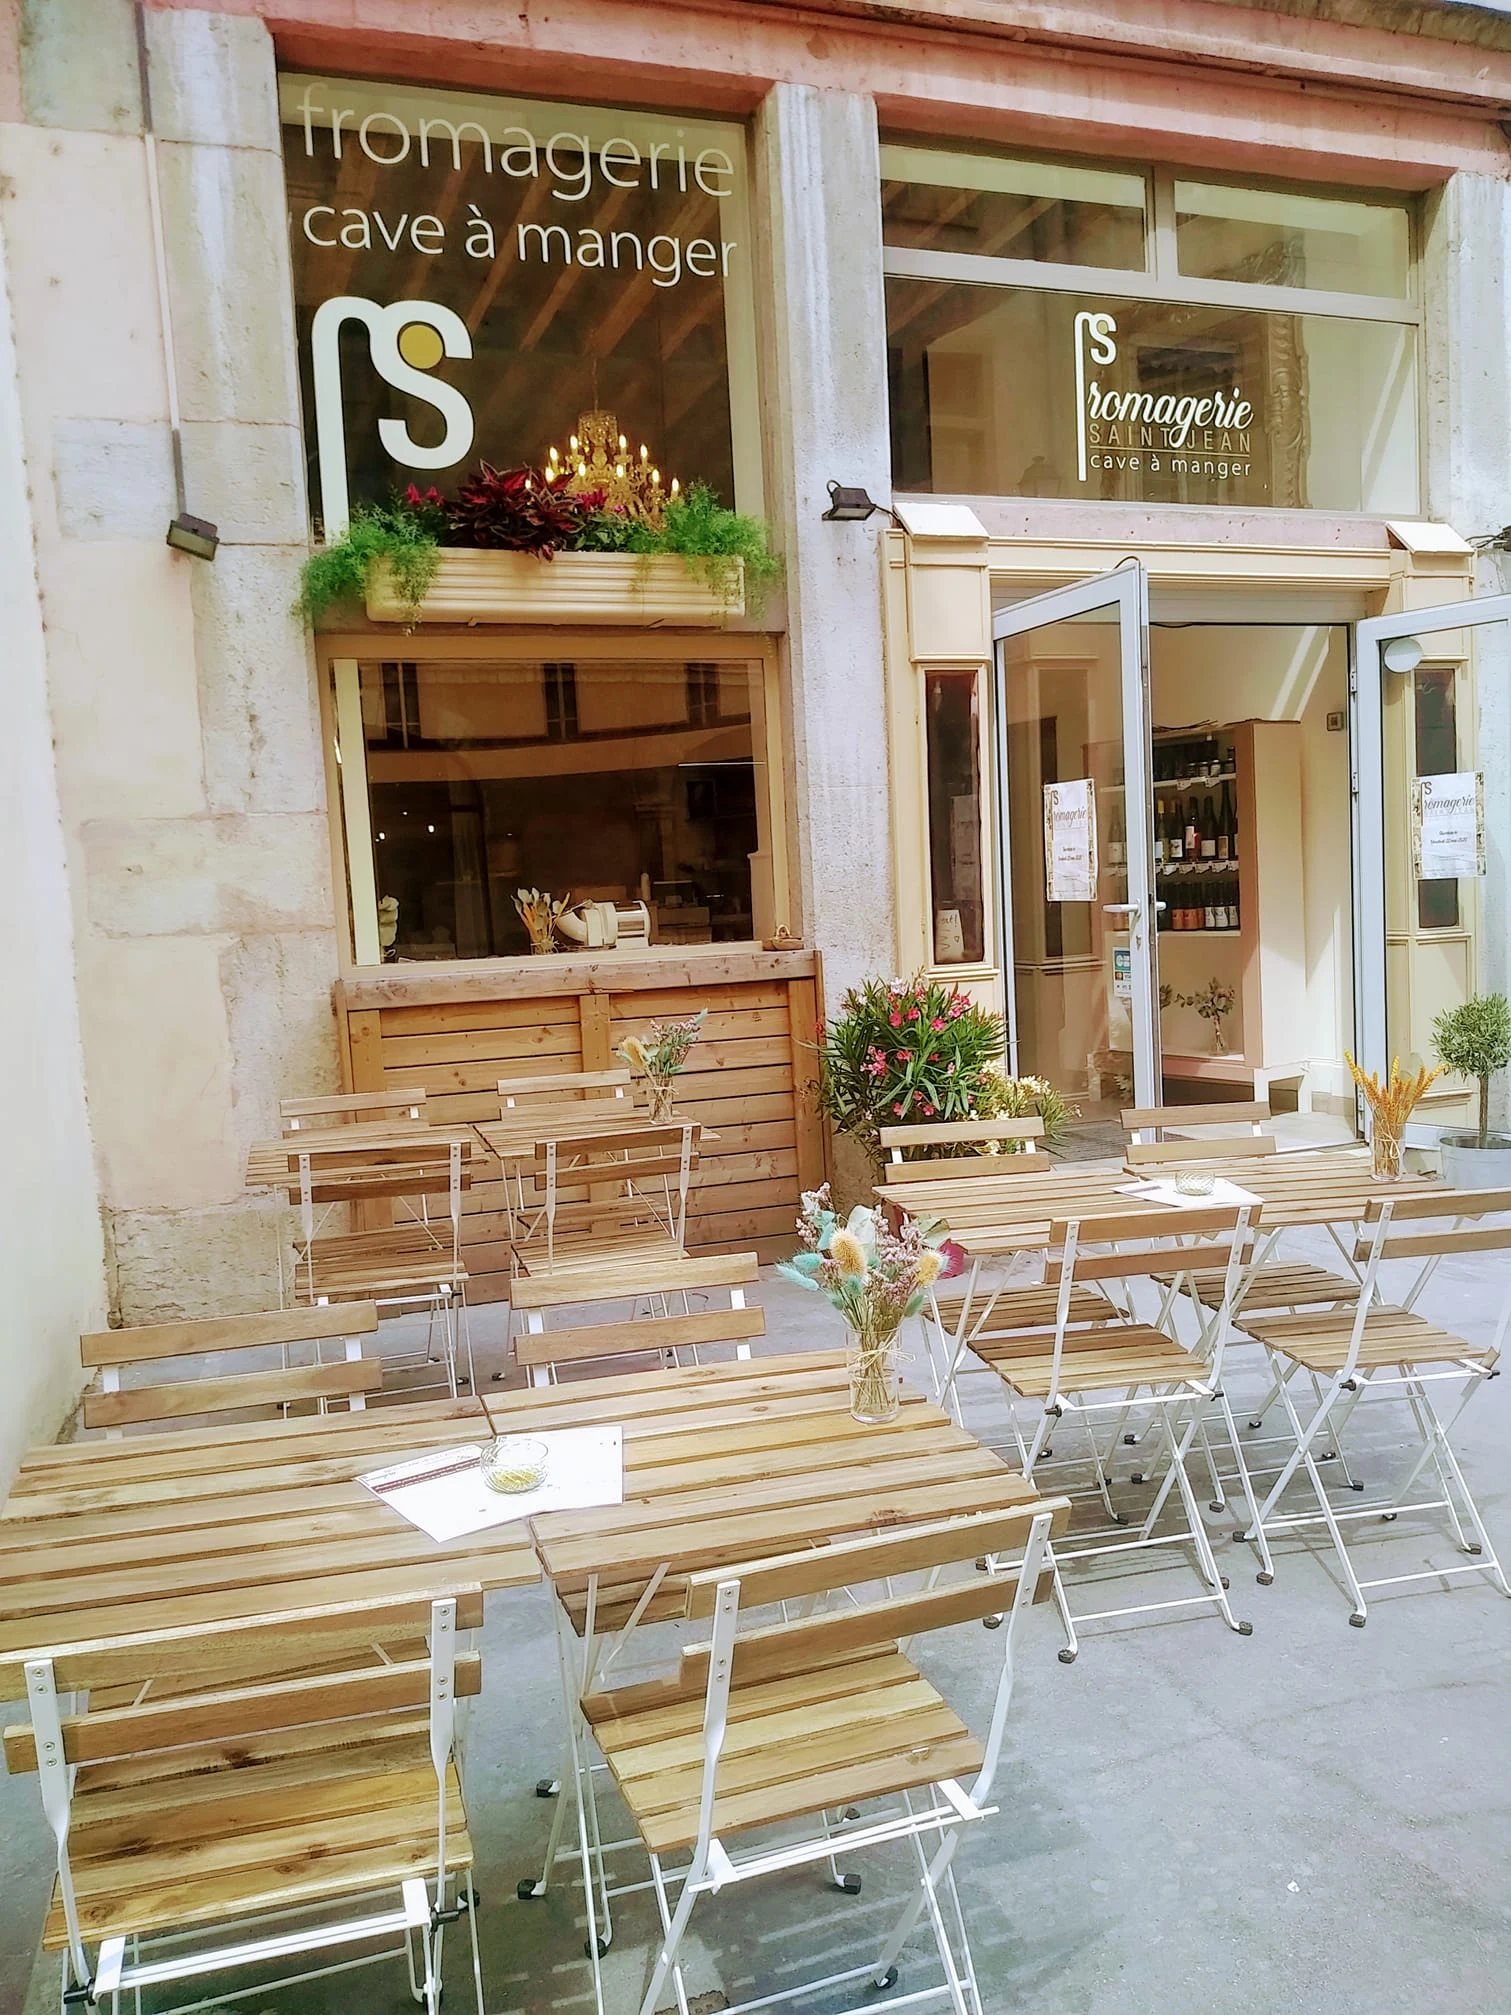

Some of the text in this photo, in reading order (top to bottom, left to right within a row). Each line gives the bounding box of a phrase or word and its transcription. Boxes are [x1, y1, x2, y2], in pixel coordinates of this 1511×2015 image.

[297, 83, 734, 200] fromagerie
[303, 204, 737, 287] cave à manger
[1089, 423, 1250, 451] SAINT JEAN
[1090, 454, 1251, 479] cave à manger
